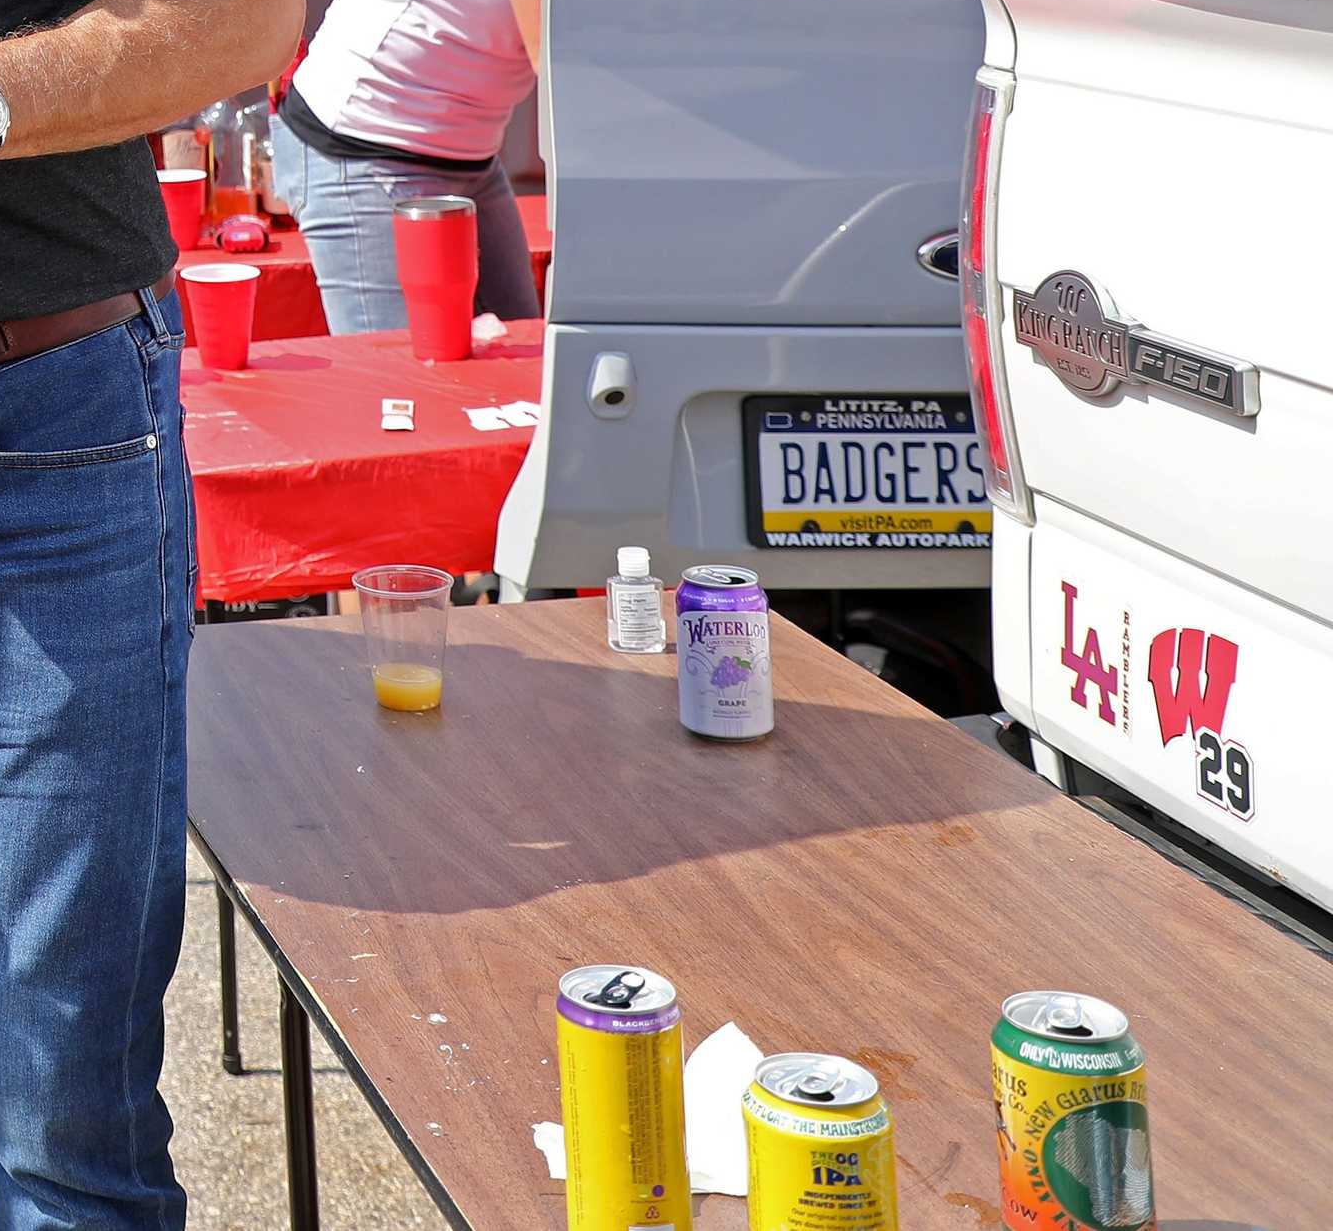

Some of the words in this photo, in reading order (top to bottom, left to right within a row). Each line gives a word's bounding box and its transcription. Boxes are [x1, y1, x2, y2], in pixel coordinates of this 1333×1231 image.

[1016, 299, 1060, 346] KING
[1061, 321, 1124, 368] RANCH
[1135, 344, 1229, 399] F-150
[815, 412, 947, 430] PENNSYLVANIA
[824, 400, 904, 414] LITITZ,
[910, 400, 942, 413] PA
[780, 441, 988, 504] BADGERS
[840, 514, 933, 531] visitPA.com
[766, 532, 872, 547] WARWICK
[875, 532, 991, 548] AUTOPARK
[682, 614, 767, 648] WATERLOO
[717, 699, 747, 707] GRAPE
[1148, 627, 1239, 748] W
[1198, 729, 1252, 817] 29
[1019, 1041, 1047, 1062] ONLY
[1061, 1050, 1124, 1070] WISCONSIN
[992, 1062, 1028, 1097] arus
[755, 1103, 788, 1128] FLOAT
[792, 1119, 816, 1134] THE
[1024, 1100, 1056, 1141] New
[1055, 1080, 1126, 1110] Glarus
[812, 1166, 862, 1186] IPA
